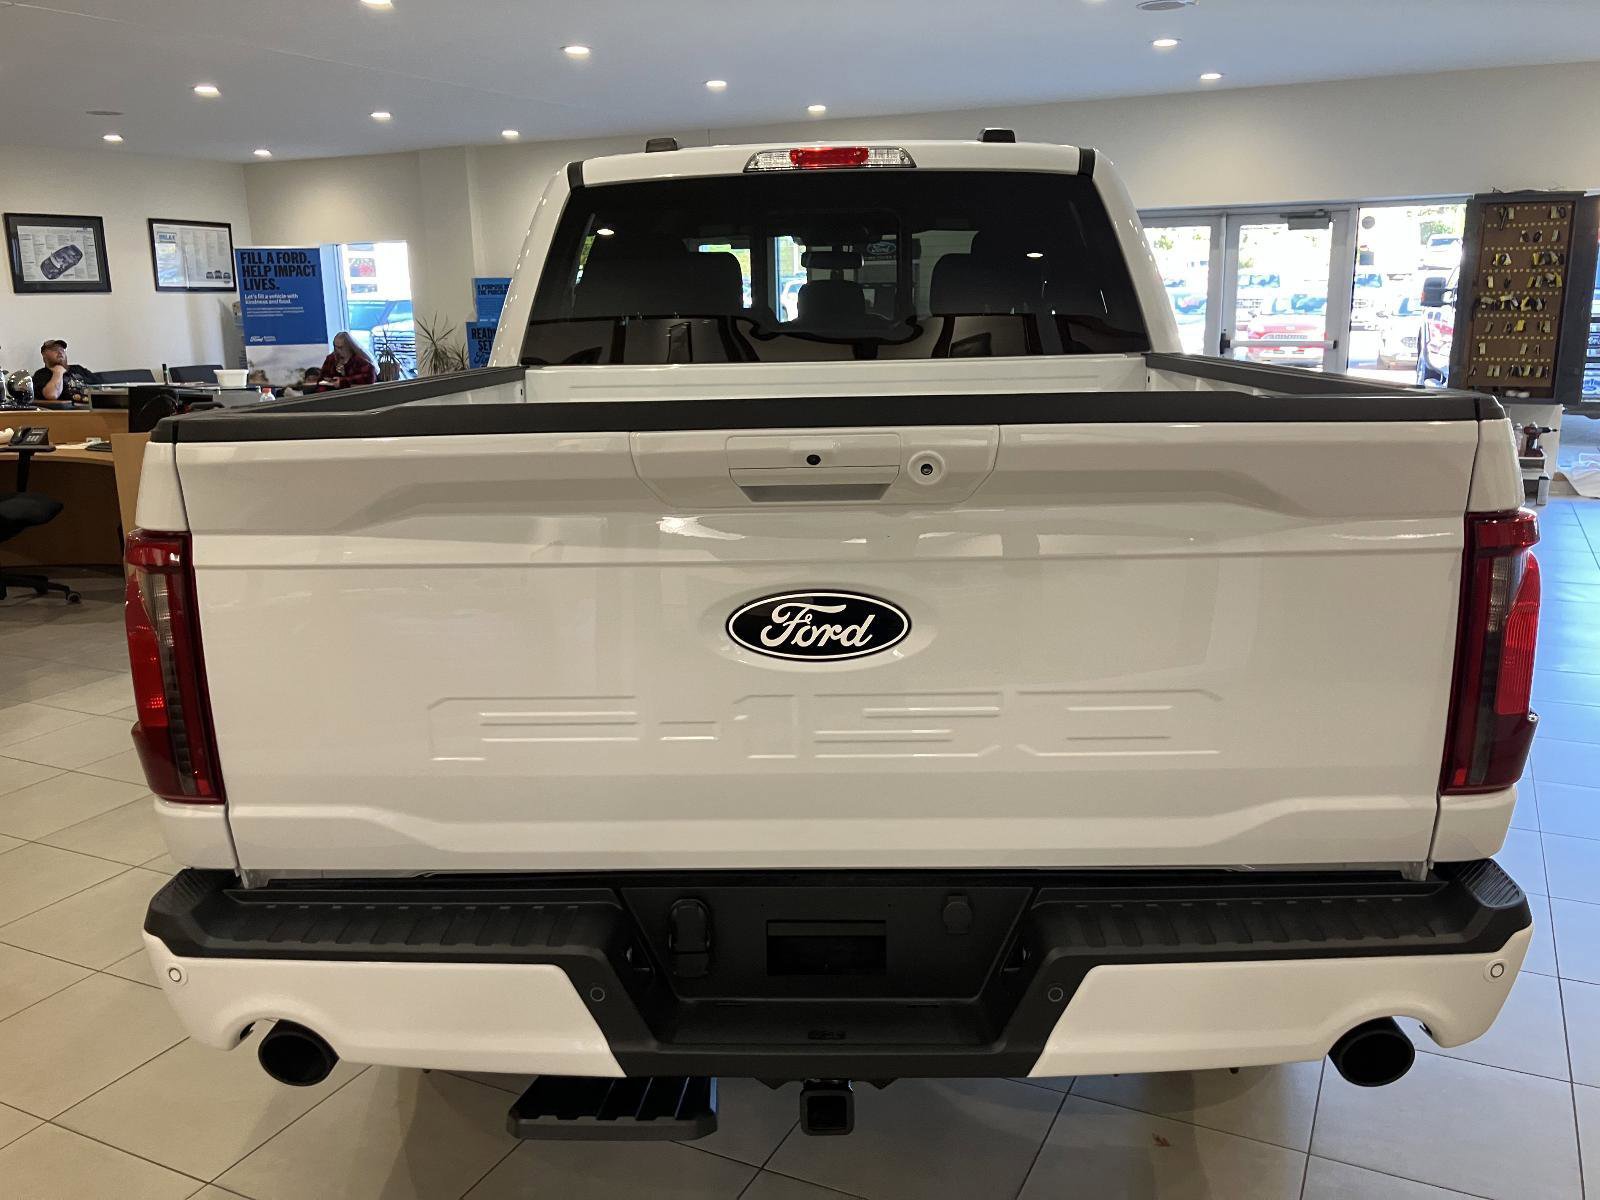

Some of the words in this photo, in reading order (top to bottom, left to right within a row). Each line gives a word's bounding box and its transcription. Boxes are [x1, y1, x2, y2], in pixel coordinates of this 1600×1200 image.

[240, 252, 264, 264] FILL
[266, 252, 275, 264] A
[276, 252, 311, 264] FORD.
[241, 265, 272, 277] HELP
[273, 265, 317, 277] IMPACT
[243, 278, 280, 291] LIVES.
[760, 602, 876, 647] Ford
